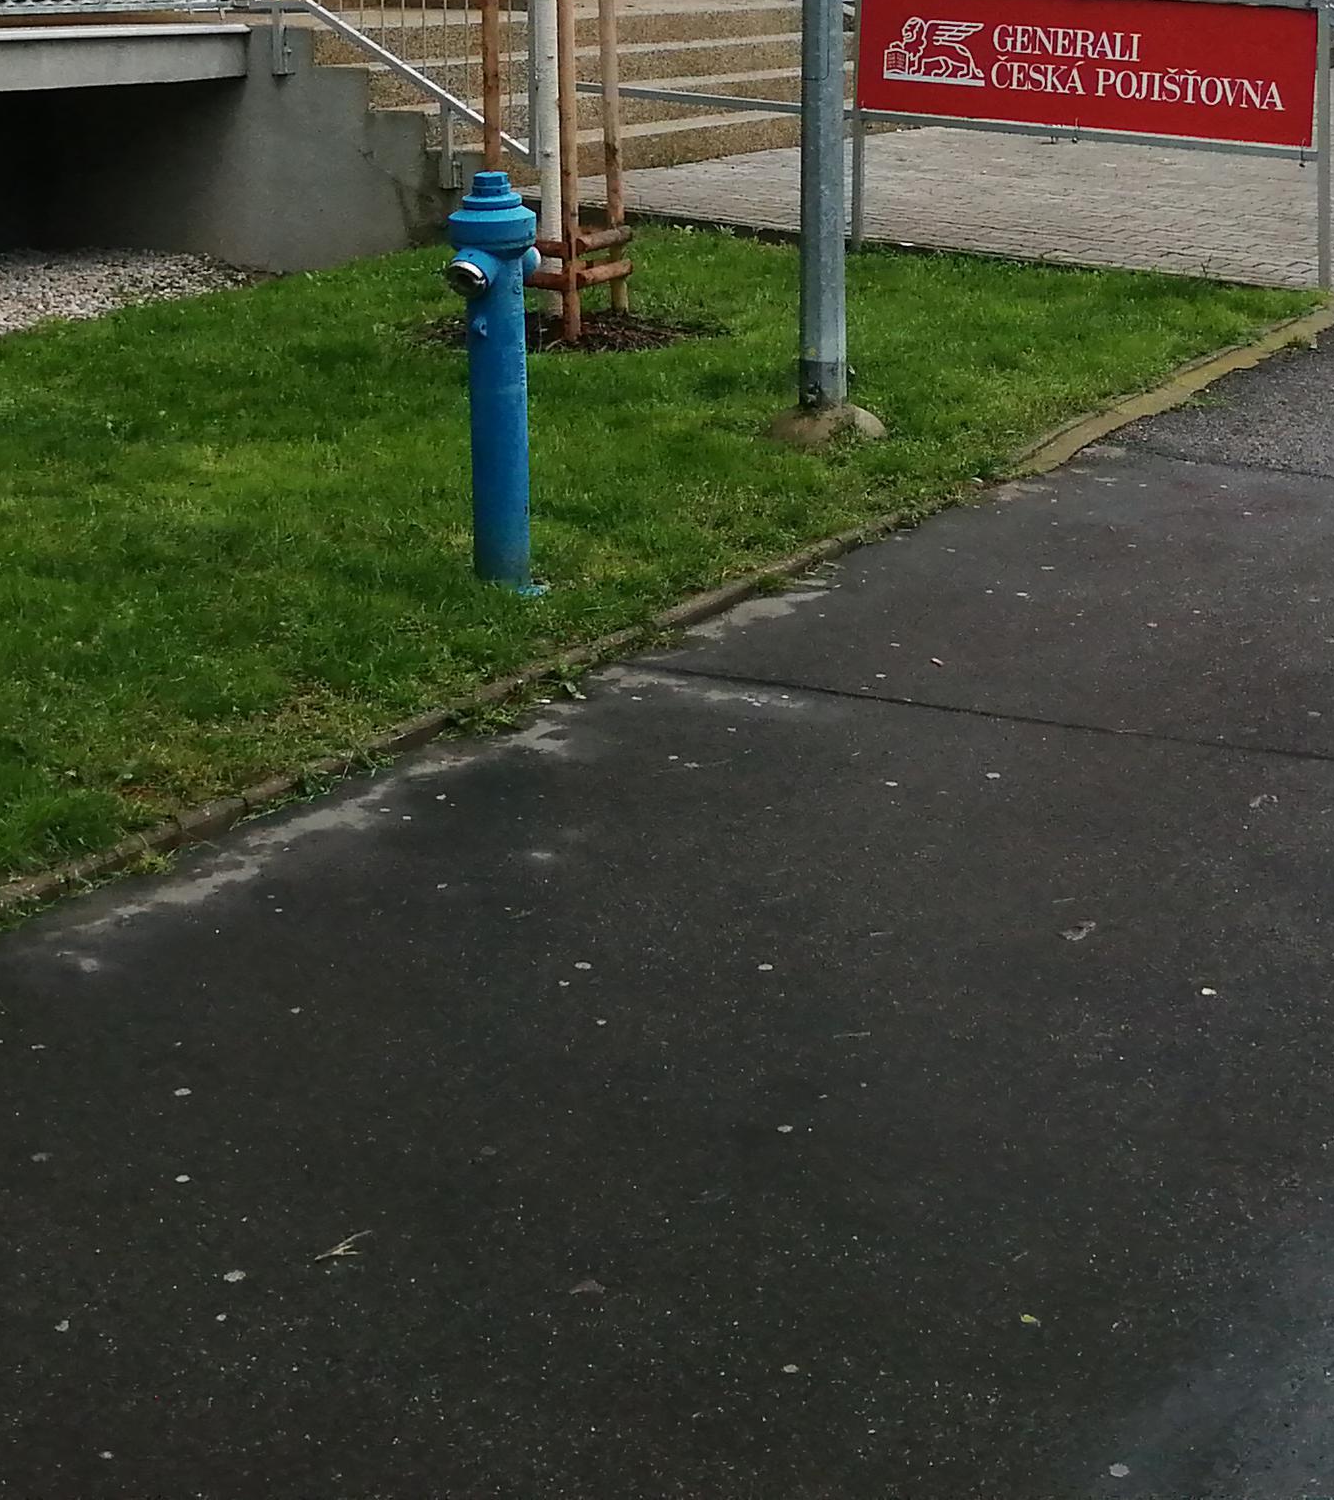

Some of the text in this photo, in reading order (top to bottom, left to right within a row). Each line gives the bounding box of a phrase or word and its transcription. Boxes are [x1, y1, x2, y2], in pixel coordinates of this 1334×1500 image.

[993, 24, 1142, 62] GENERALI
[991, 56, 1285, 111] ČESKÁ POJIŠŤOVNA
